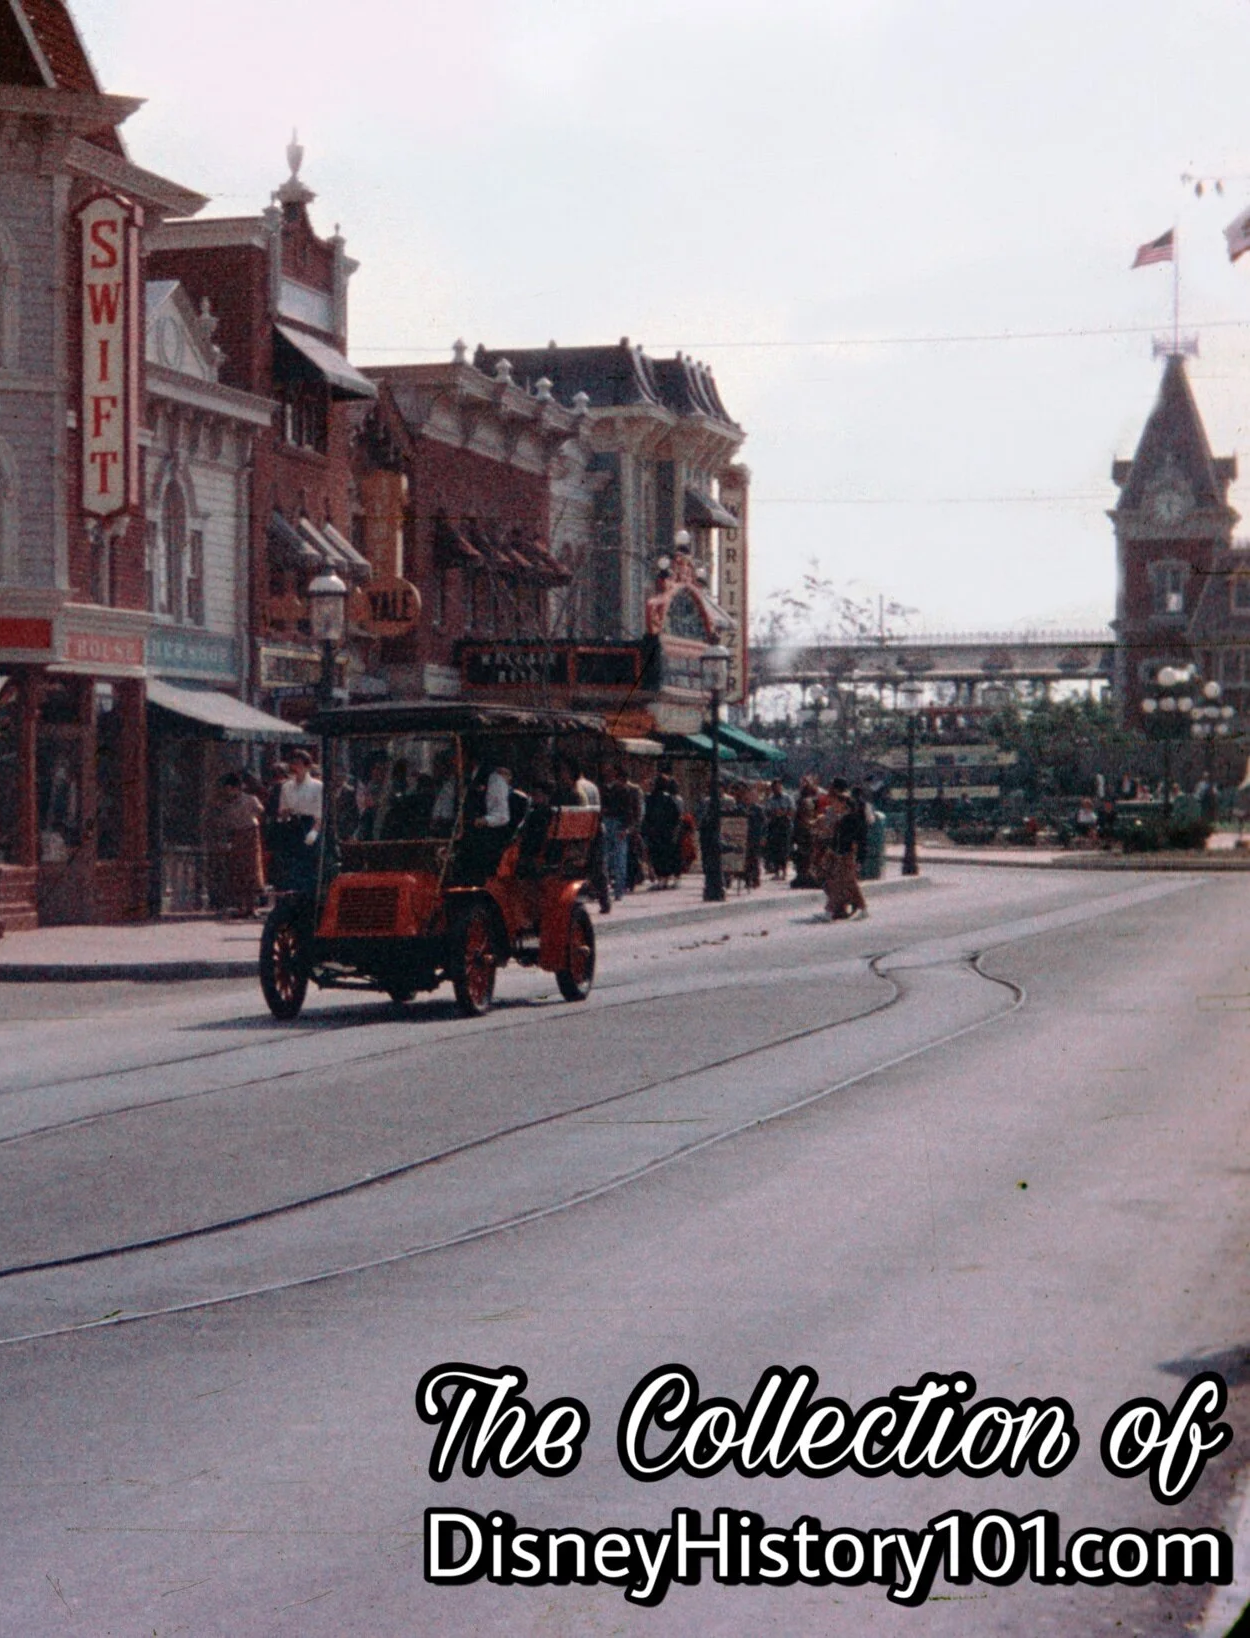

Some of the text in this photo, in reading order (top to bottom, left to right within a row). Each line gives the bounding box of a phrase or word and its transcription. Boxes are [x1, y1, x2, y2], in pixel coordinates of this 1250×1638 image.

[87, 218, 123, 495] SWIFT
[367, 589, 414, 622] YALE
[77, 637, 137, 661] HOUSE
